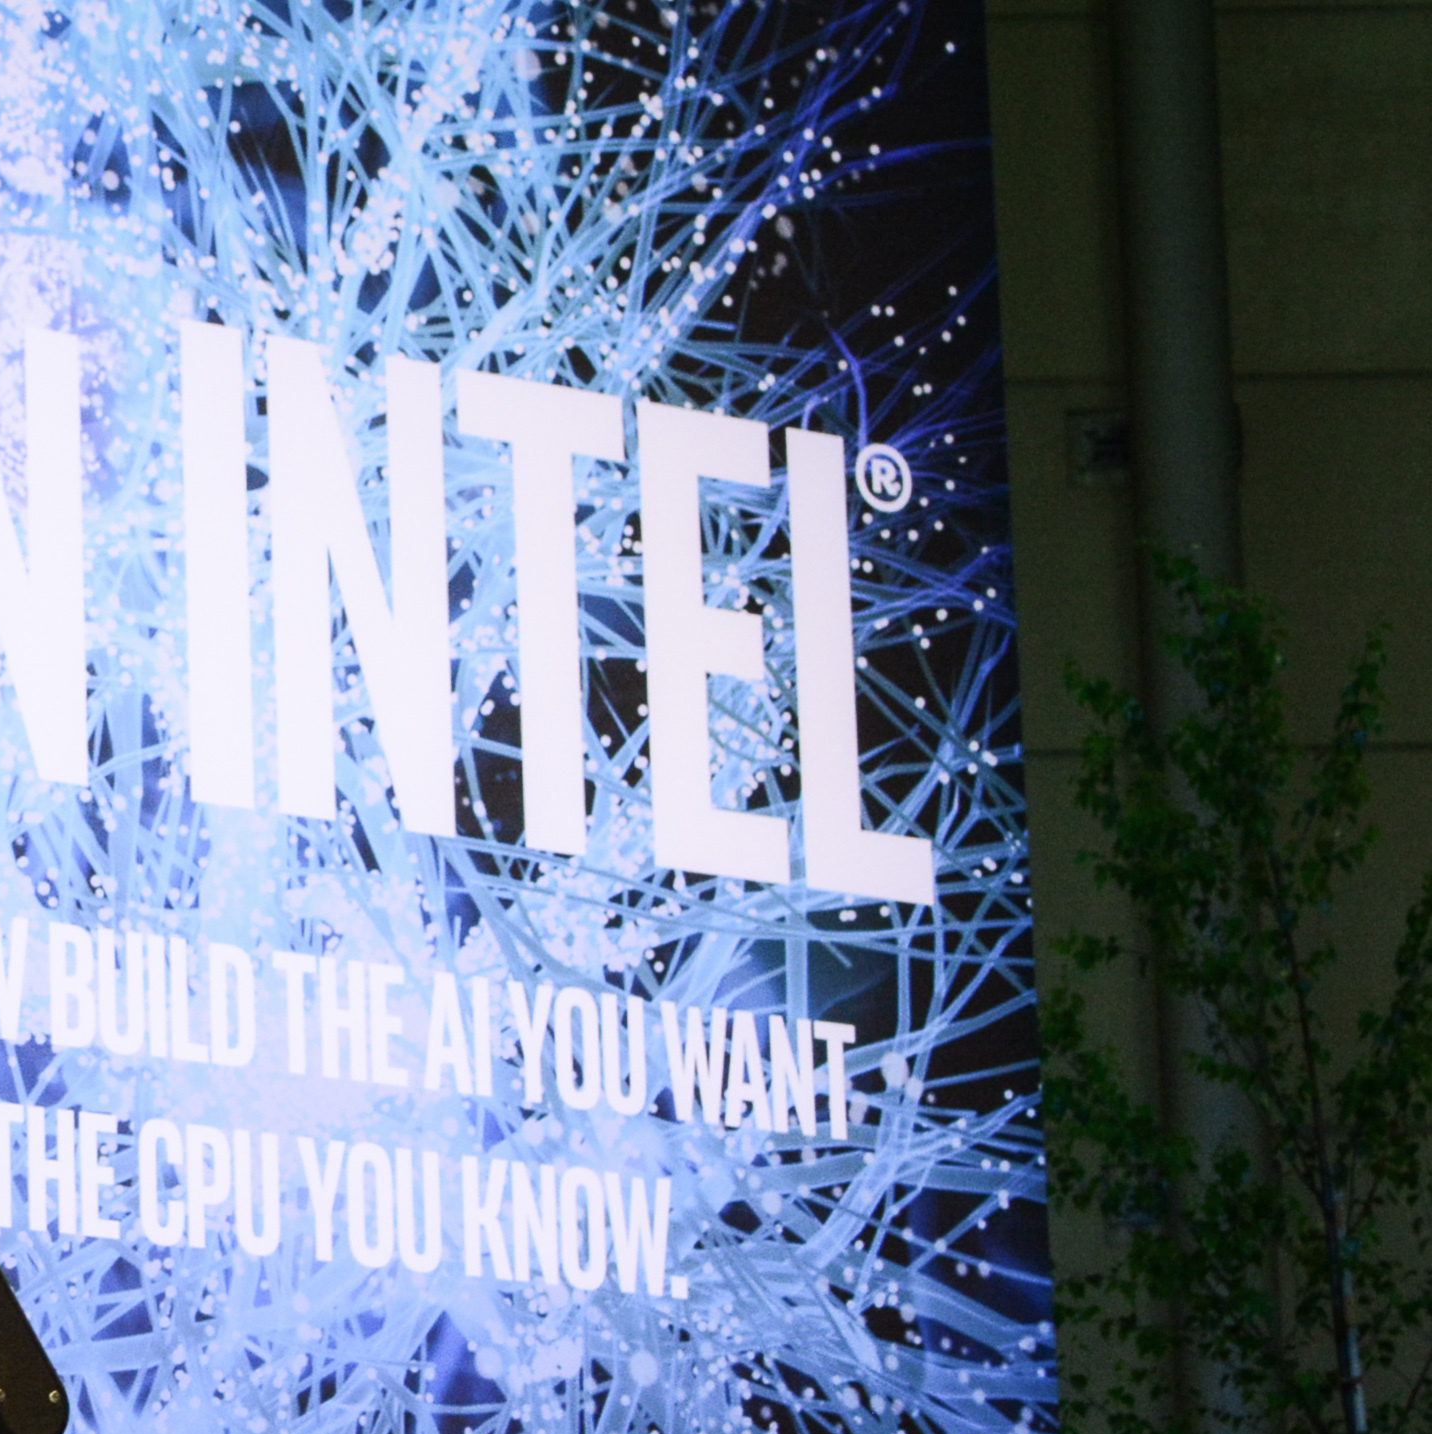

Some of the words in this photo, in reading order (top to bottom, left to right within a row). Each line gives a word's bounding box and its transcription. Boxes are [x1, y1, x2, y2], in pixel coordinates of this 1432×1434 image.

[48, 921, 257, 1068] BUILD
[272, 950, 409, 1087] THE
[424, 971, 493, 1097] AI
[507, 979, 647, 1116] YOU
[661, 1001, 857, 1141] WANT
[139, 1117, 282, 1257] CPU
[298, 1136, 442, 1274] YOU
[462, 1154, 690, 1301] KNOW.
